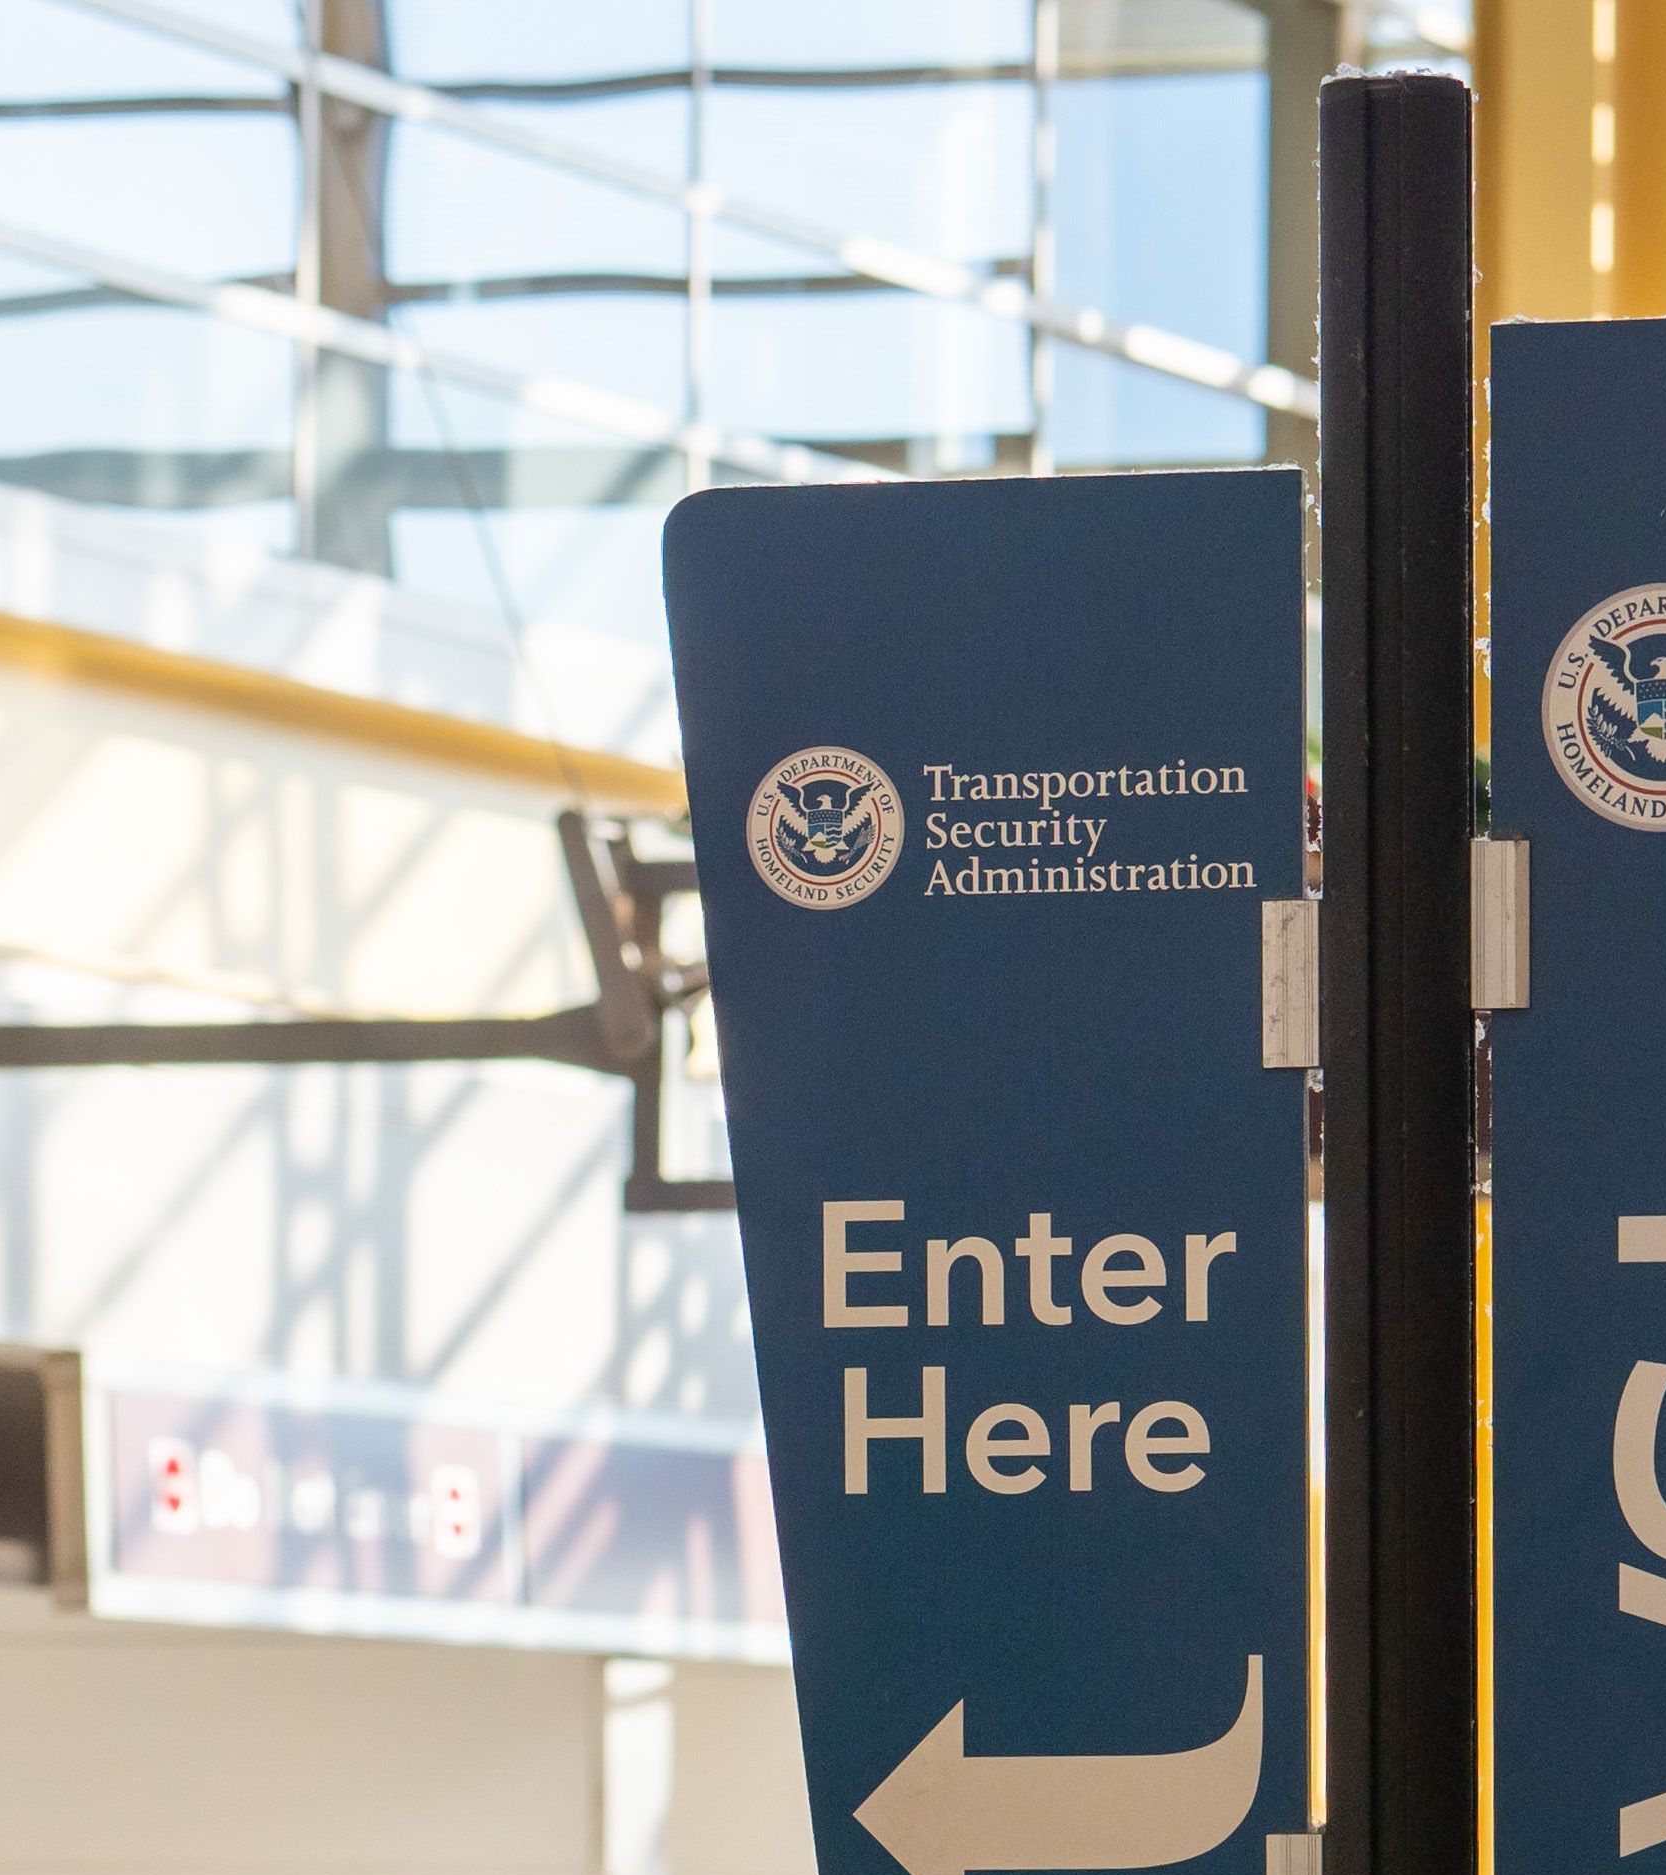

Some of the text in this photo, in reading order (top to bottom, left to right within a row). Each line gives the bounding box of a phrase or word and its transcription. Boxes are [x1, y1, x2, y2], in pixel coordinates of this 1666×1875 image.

[1558, 650, 1590, 690] U.S.
[756, 754, 896, 818] U.S. DEPARTMENT OF
[923, 760, 1248, 810] Transportation
[925, 810, 1107, 858] Security
[755, 833, 896, 902] HOMELAND SECURITY
[923, 852, 1257, 896] Administration
[822, 1199, 1237, 1329] Enter
[844, 1366, 1211, 1495] Here
